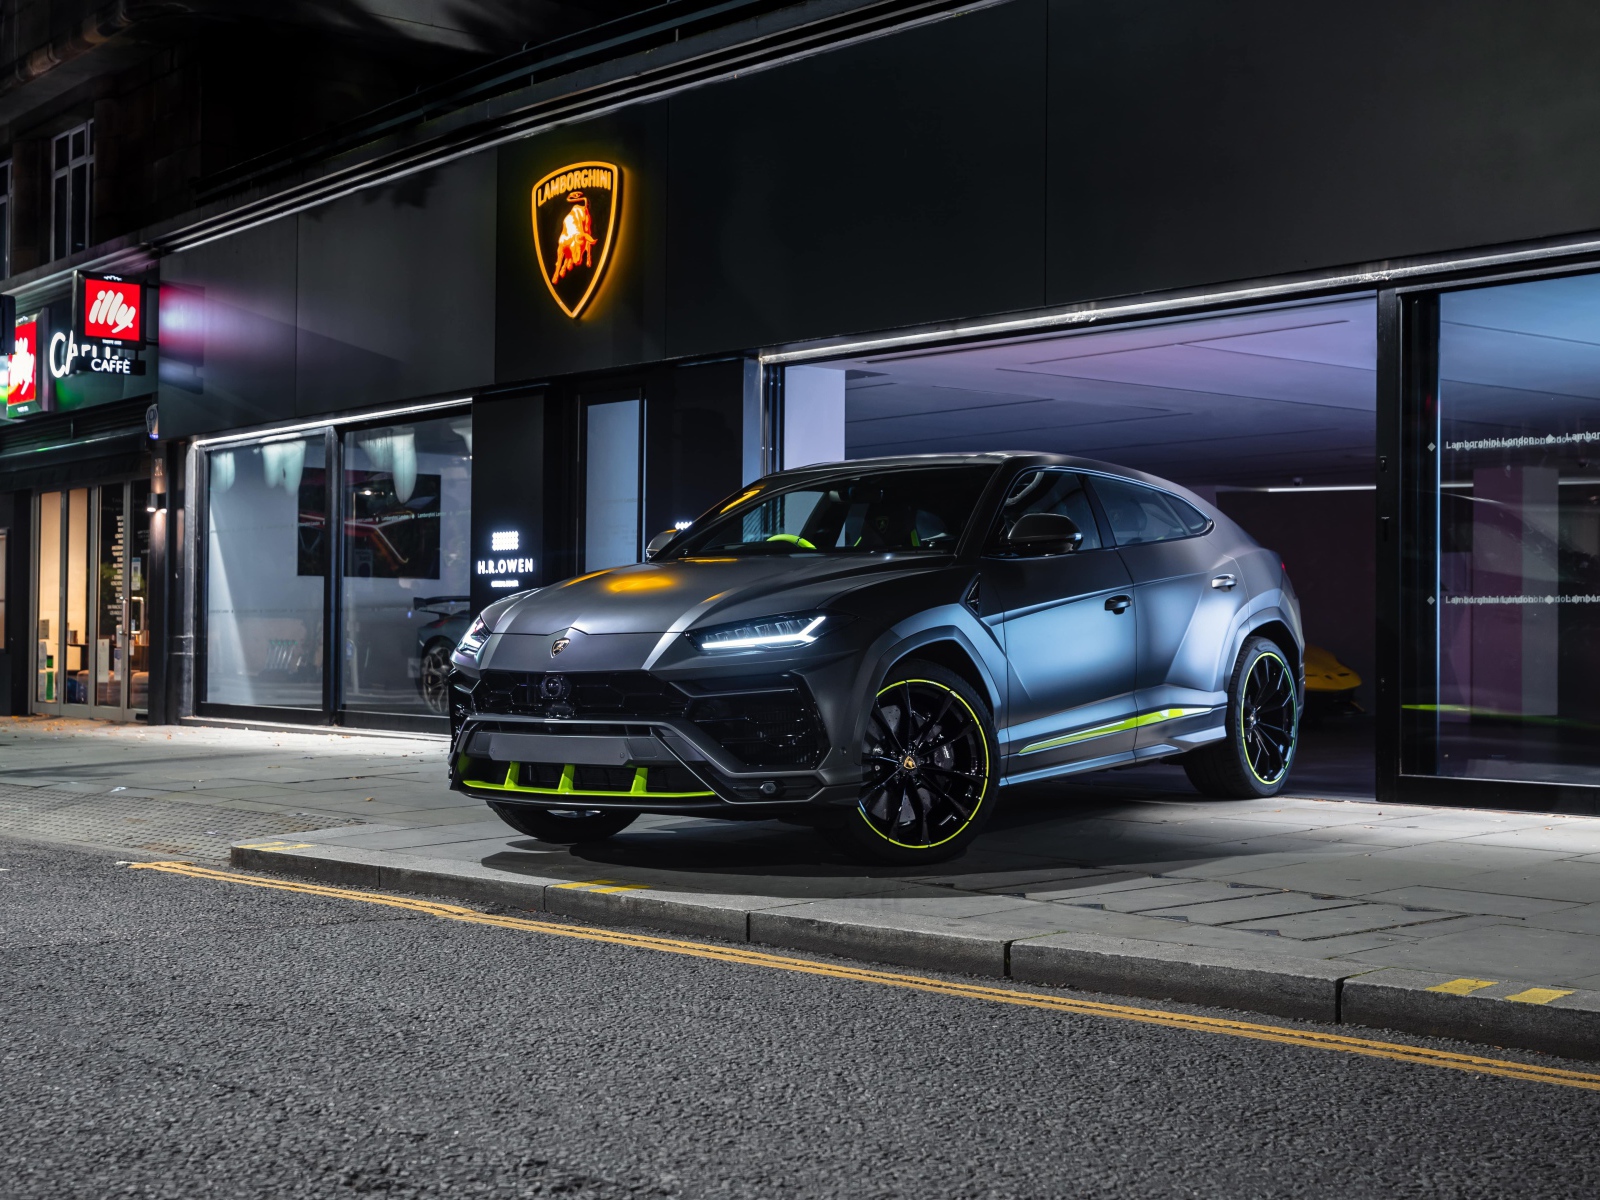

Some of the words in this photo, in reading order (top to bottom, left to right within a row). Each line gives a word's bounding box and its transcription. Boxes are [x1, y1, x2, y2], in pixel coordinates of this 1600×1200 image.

[537, 168, 612, 207] LAMBORGHINI
[88, 289, 137, 334] illy
[91, 357, 131, 374] CAFFÈ
